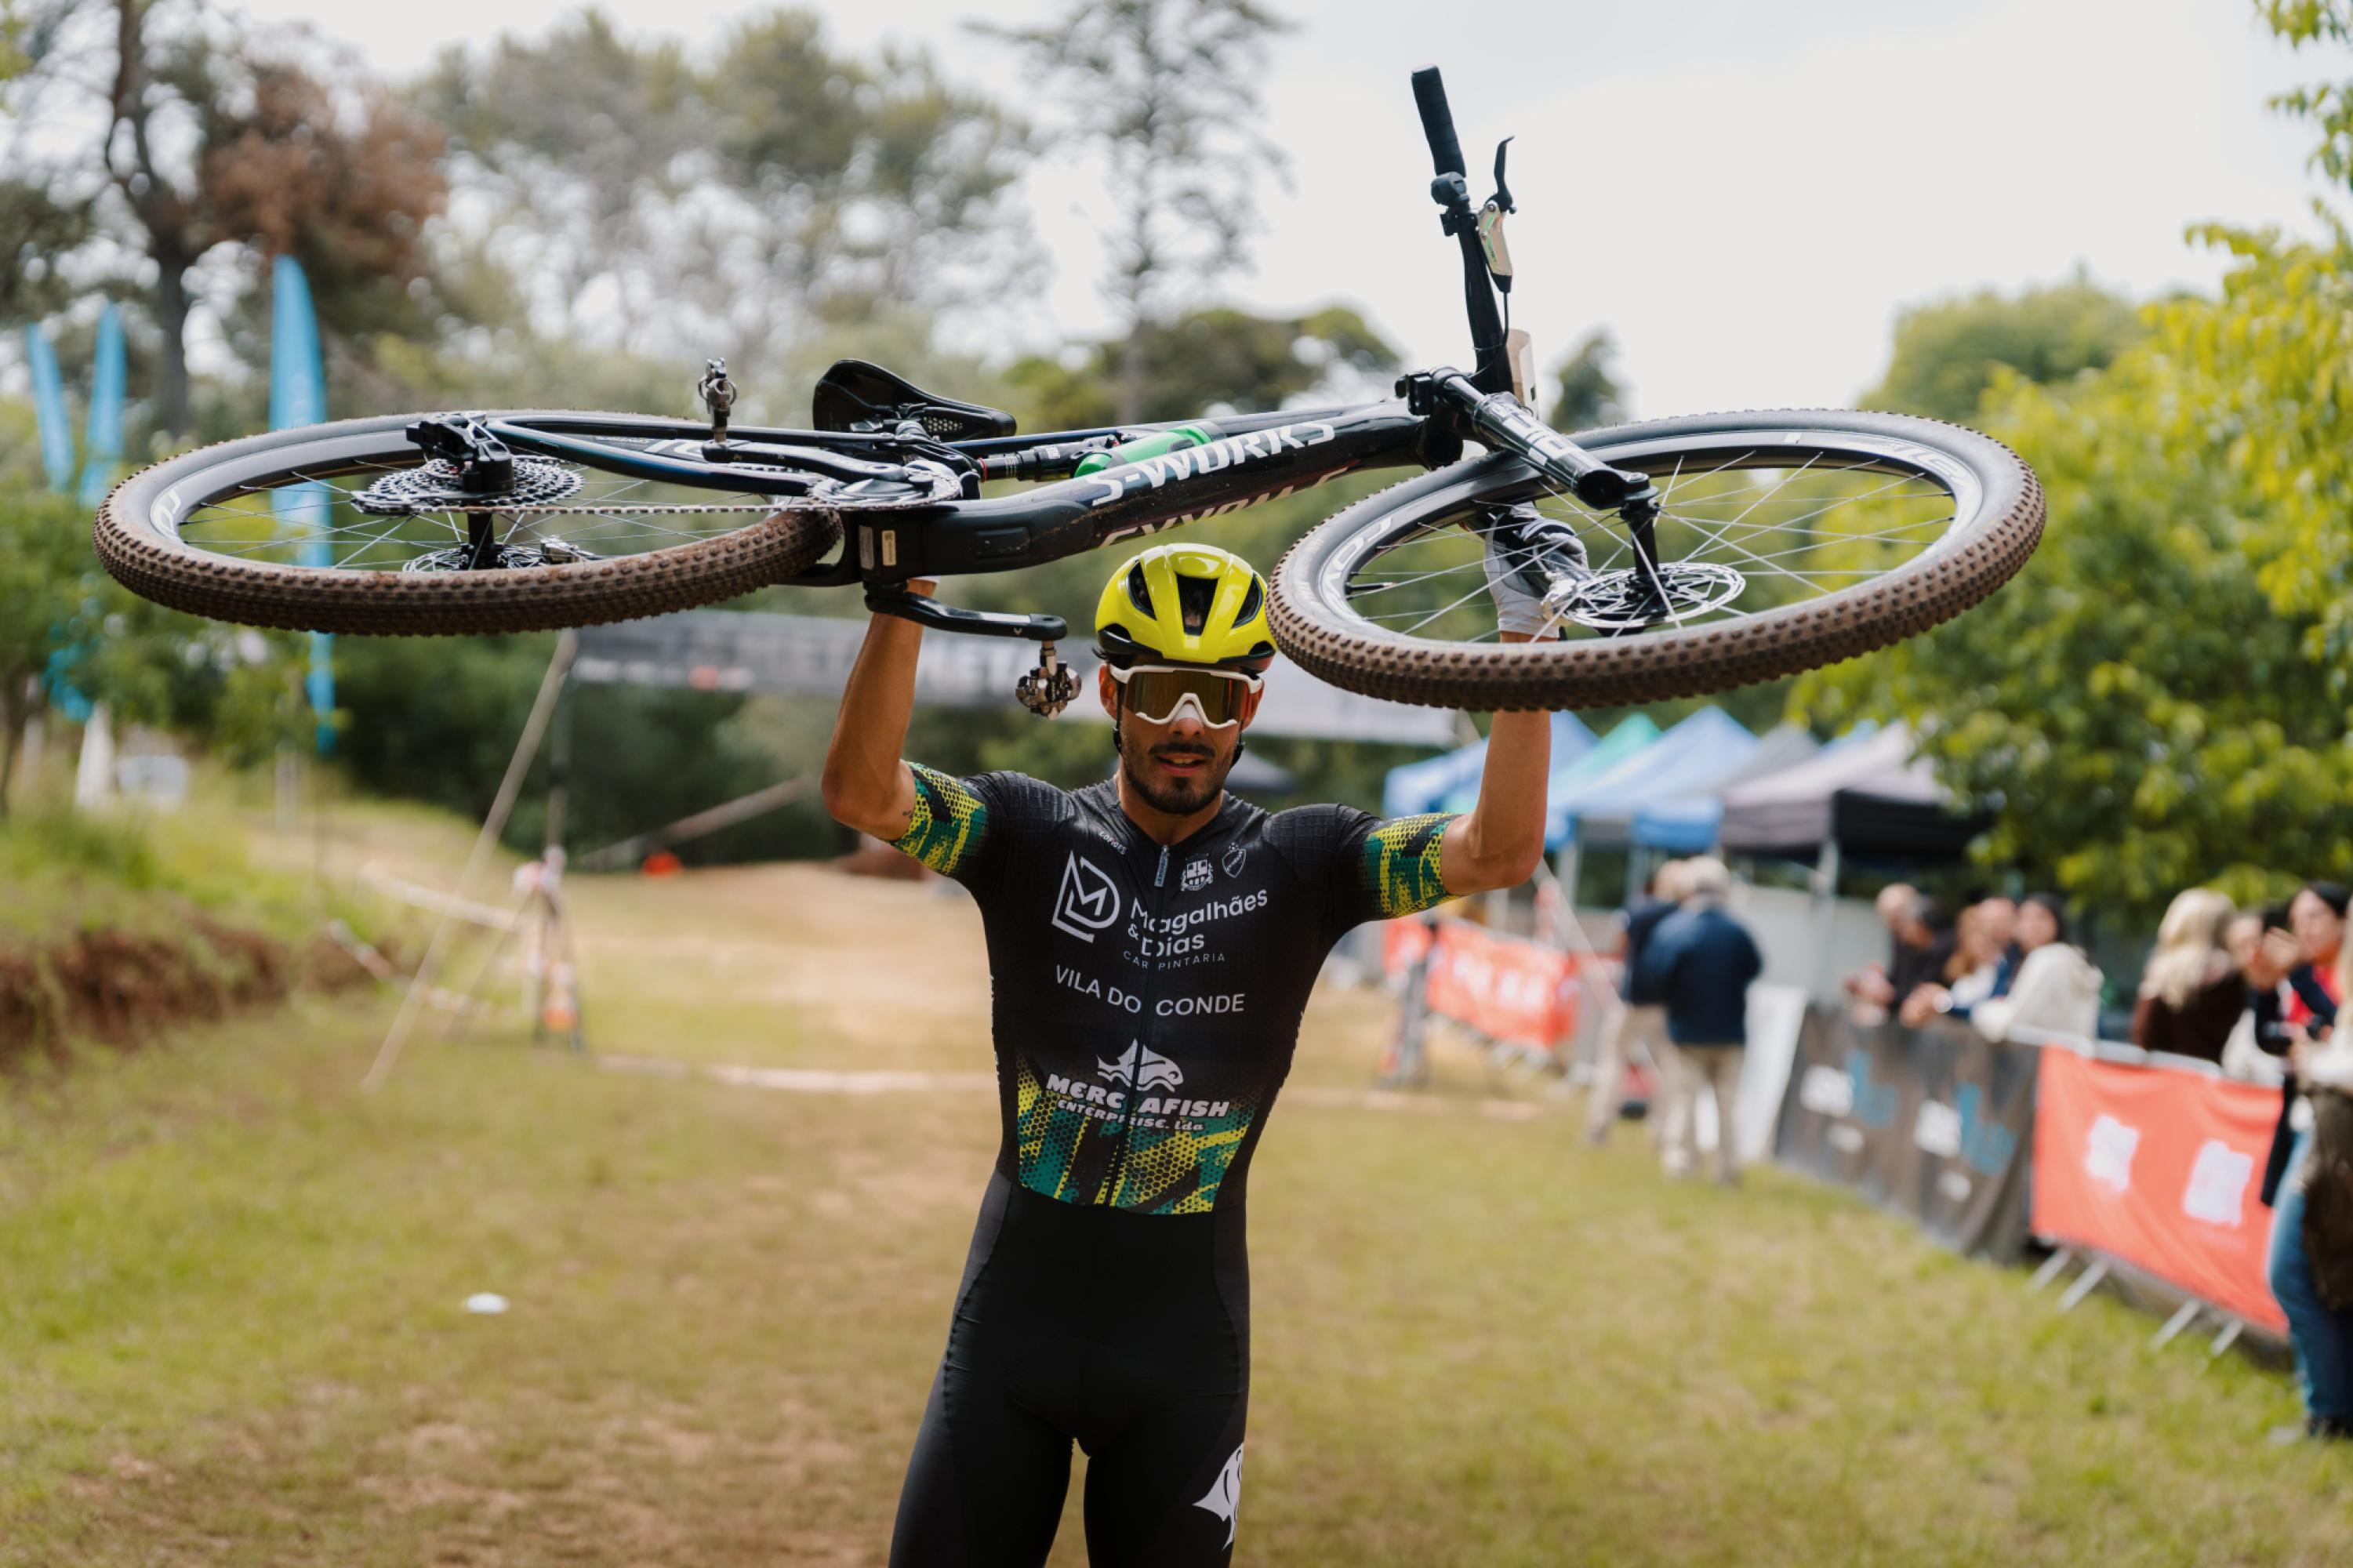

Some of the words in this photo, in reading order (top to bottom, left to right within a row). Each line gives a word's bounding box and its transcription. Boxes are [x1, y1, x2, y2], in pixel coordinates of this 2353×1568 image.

[1131, 889, 1268, 935] Magalhães
[1127, 923, 1139, 941] &
[1141, 934, 1205, 957] Dias
[1056, 964, 1101, 999] VILA
[1107, 986, 1142, 1014] DO
[1156, 993, 1245, 1016] CONDE
